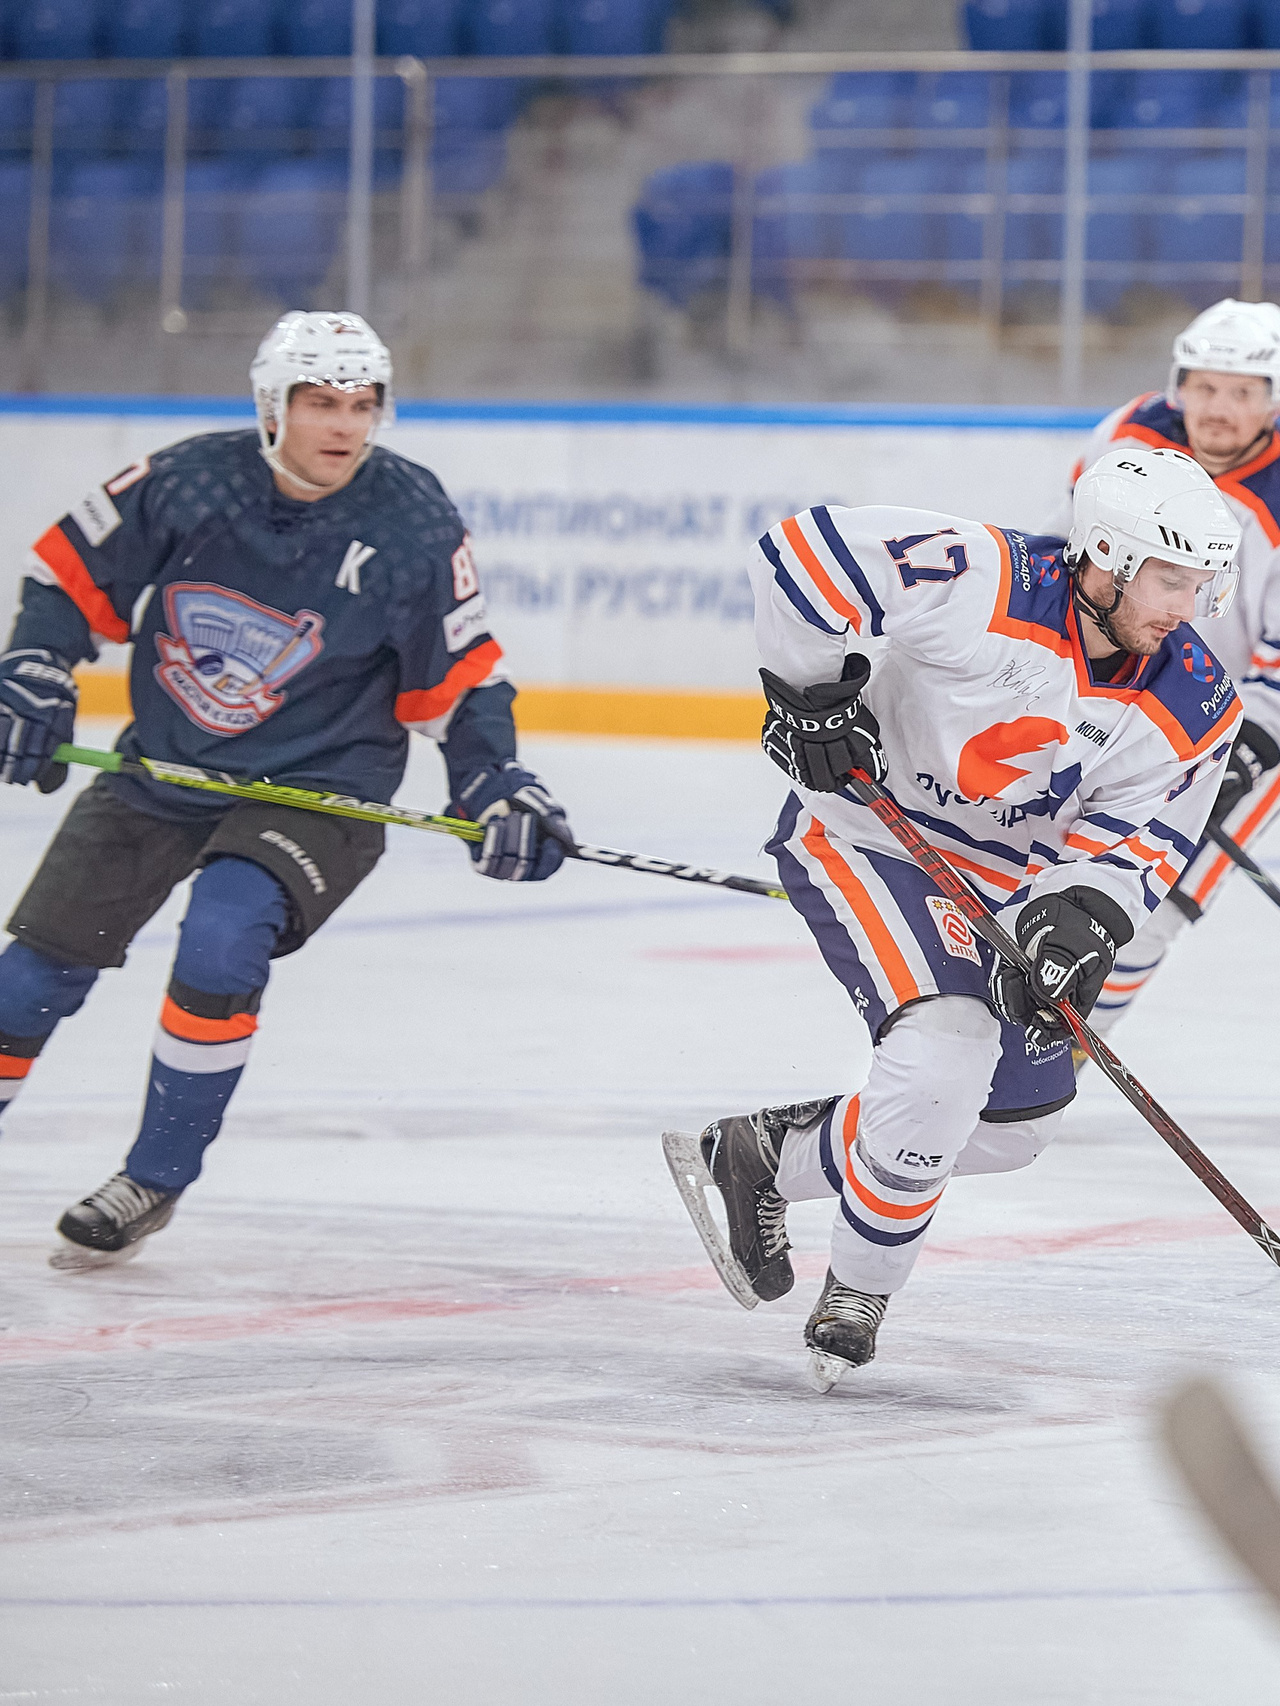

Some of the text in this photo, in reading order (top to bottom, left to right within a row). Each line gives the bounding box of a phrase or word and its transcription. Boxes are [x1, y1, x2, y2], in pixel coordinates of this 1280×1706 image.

[461, 491, 728, 540] ЕМПИОНАТ
[880, 526, 972, 592] 17
[1207, 541, 1235, 552] CCM
[1074, 720, 1110, 748] МОЛН
